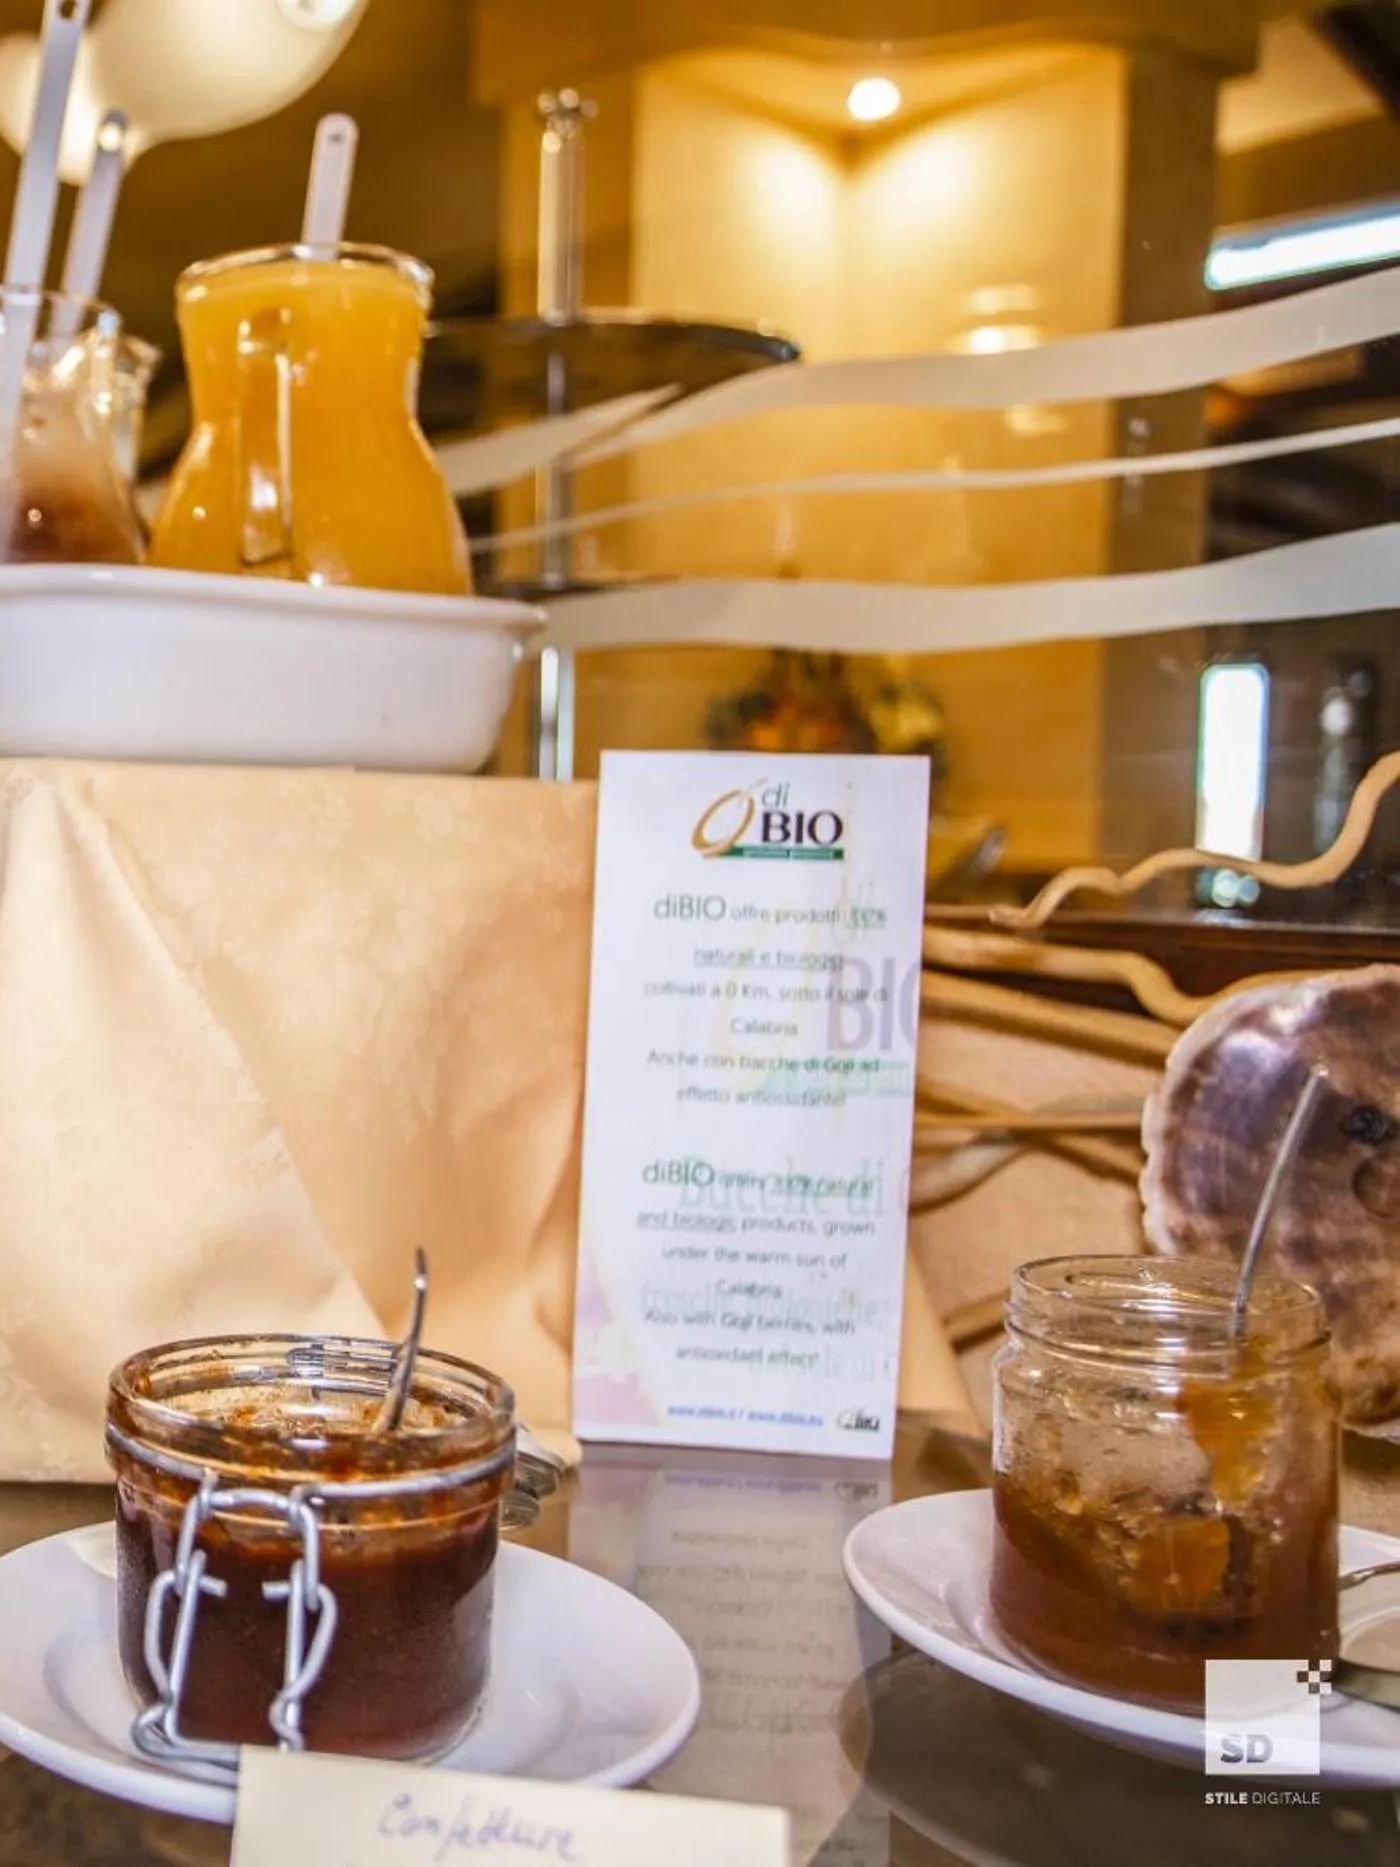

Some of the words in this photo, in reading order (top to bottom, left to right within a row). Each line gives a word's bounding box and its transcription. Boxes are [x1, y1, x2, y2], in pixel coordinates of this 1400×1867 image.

[762, 781, 791, 808] di
[761, 810, 844, 845] BIO
[653, 894, 727, 921] diBIO
[731, 906, 771, 923] offre
[775, 907, 842, 926] prodotti
[644, 980, 706, 997] coltivati
[730, 1018, 799, 1037] Calabria
[647, 1050, 699, 1067] Anche
[740, 1053, 800, 1072] bacche
[823, 1058, 855, 1077] Goji
[860, 1058, 880, 1073] ad
[676, 1086, 731, 1105] effetto
[643, 1158, 715, 1188] diBIO
[823, 1219, 876, 1237] grown
[662, 1246, 708, 1261] under
[714, 1246, 741, 1262] the
[746, 1251, 791, 1266] warm
[797, 1253, 826, 1267] sun
[829, 1252, 848, 1268] of
[684, 1310, 716, 1326] with
[721, 1314, 753, 1335] Goji
[821, 1319, 856, 1336] with
